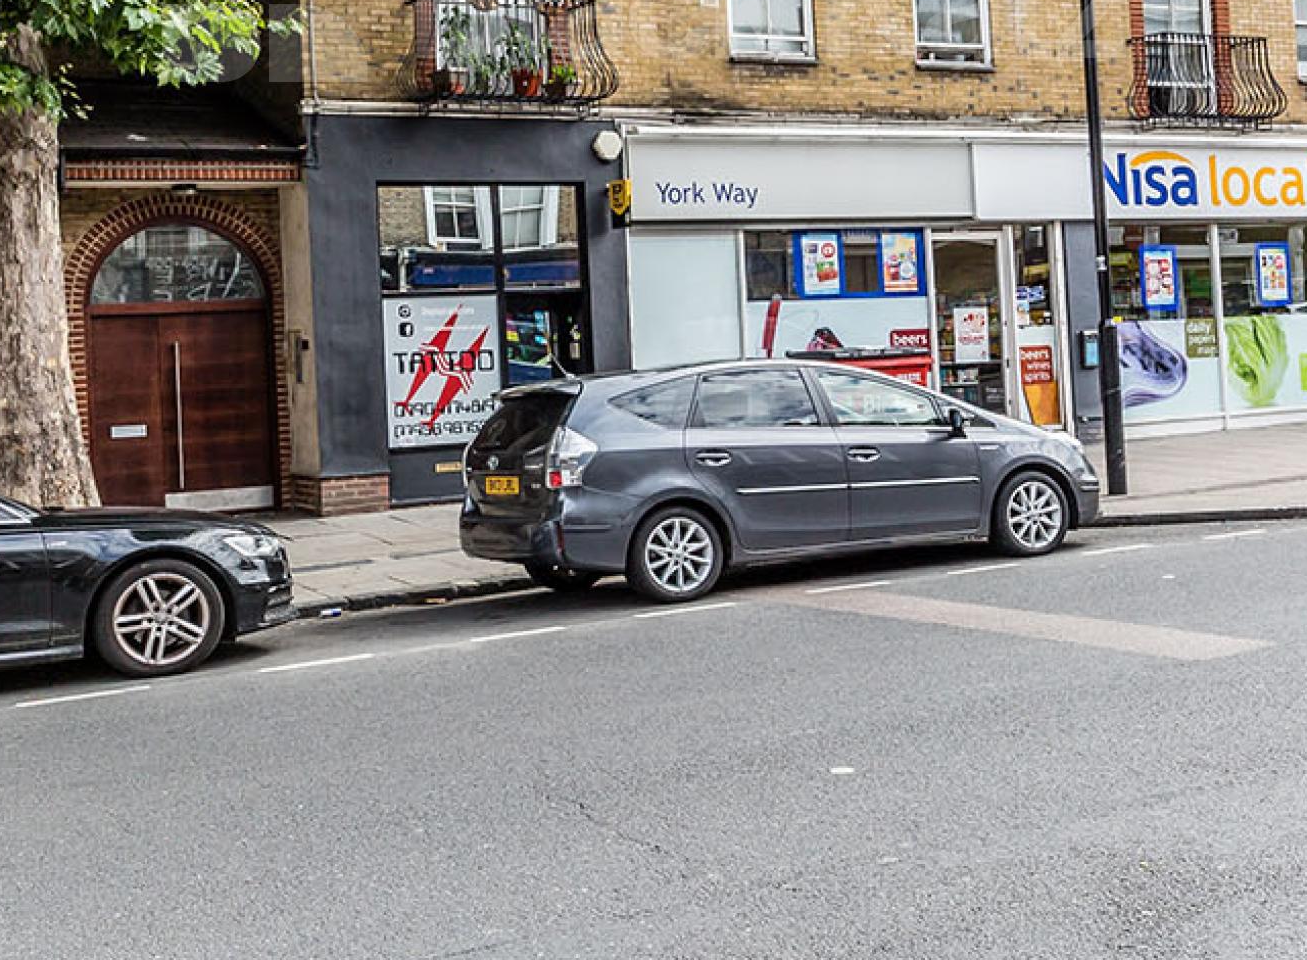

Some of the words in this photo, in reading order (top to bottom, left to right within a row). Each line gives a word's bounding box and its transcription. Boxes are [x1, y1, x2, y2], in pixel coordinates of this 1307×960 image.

[655, 182, 705, 204] York
[713, 182, 759, 208] Way
[393, 348, 495, 374] TATTOO
